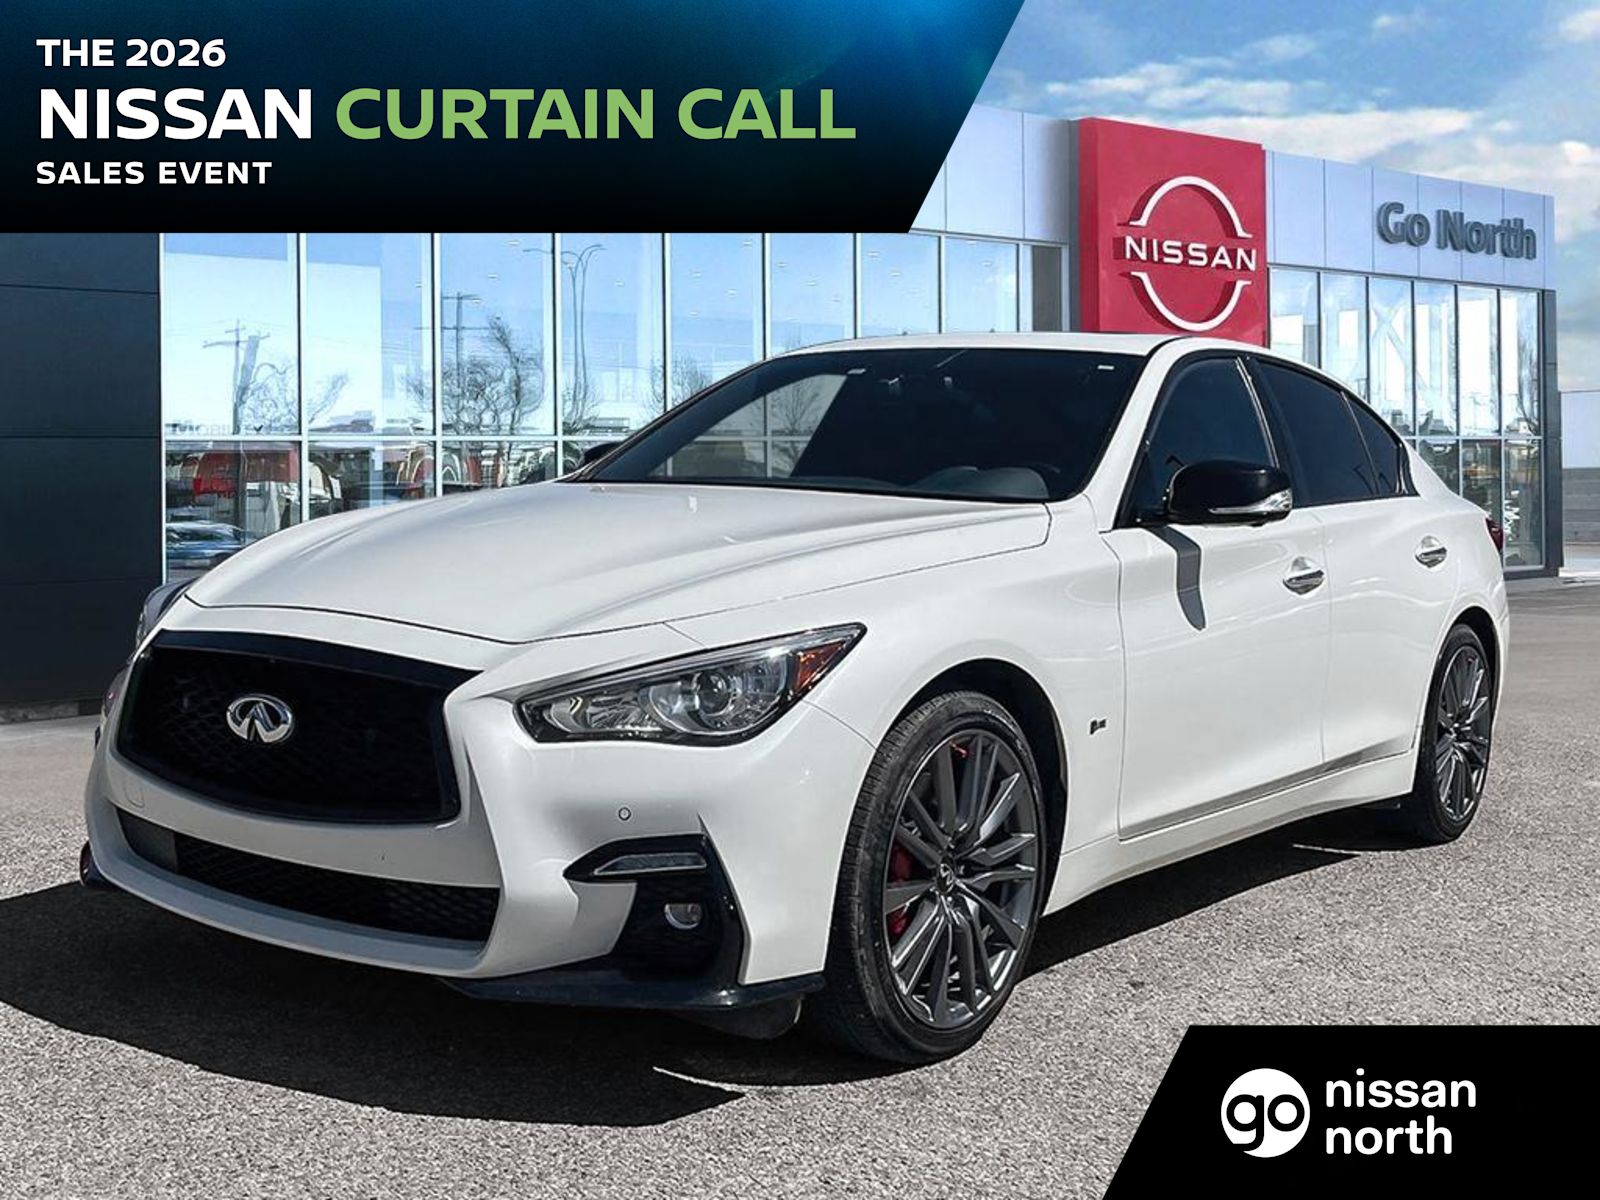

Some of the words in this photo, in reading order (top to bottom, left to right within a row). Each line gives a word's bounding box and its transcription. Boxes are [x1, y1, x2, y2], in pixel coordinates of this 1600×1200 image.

[1125, 235, 1256, 271] NISSAN
[1377, 201, 1430, 247] Go
[1436, 209, 1537, 260] North
